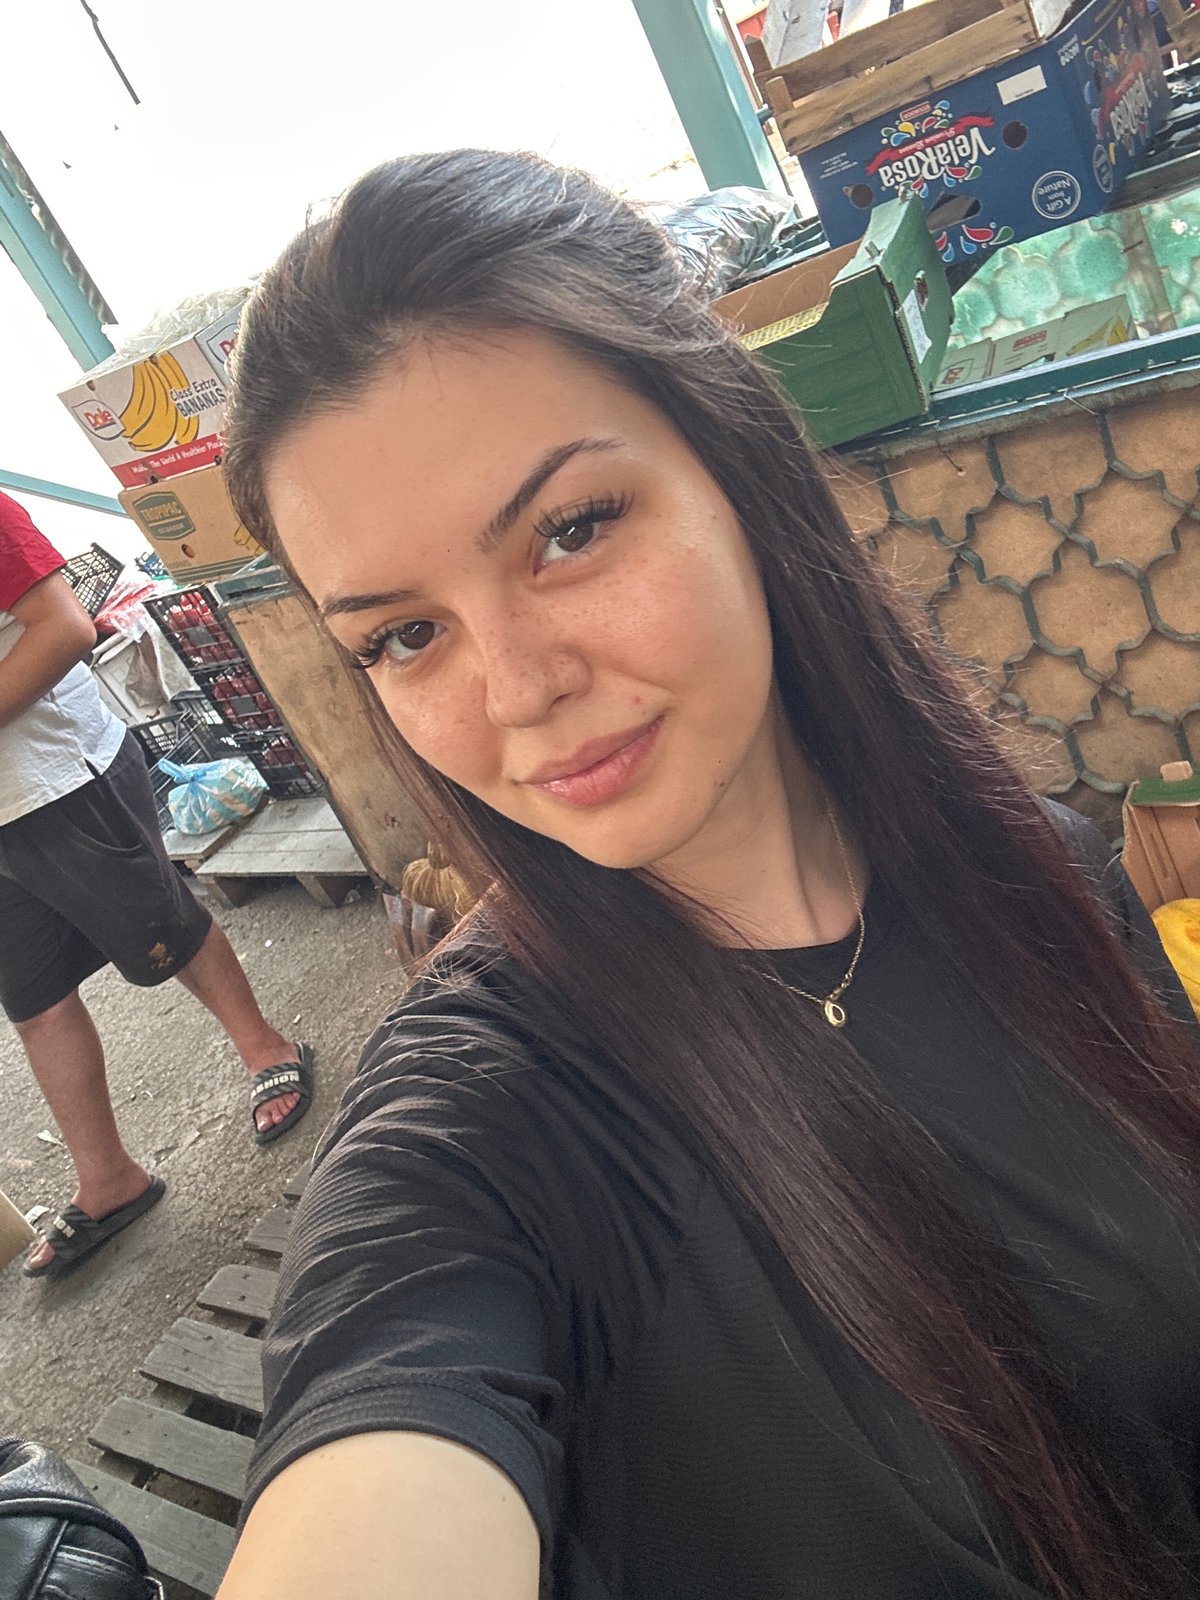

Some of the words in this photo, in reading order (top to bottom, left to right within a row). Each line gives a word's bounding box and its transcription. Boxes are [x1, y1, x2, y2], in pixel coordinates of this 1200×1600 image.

[878, 127, 996, 187] VelaRosa
[1037, 177, 1071, 196] Nature
[1045, 199, 1064, 212] Gift
[1062, 195, 1072, 205] A
[170, 388, 193, 402] Class
[192, 379, 217, 393] Extra
[176, 387, 227, 417] BANANAS
[83, 408, 115, 428] Dole
[53, 1215, 76, 1238] ION
